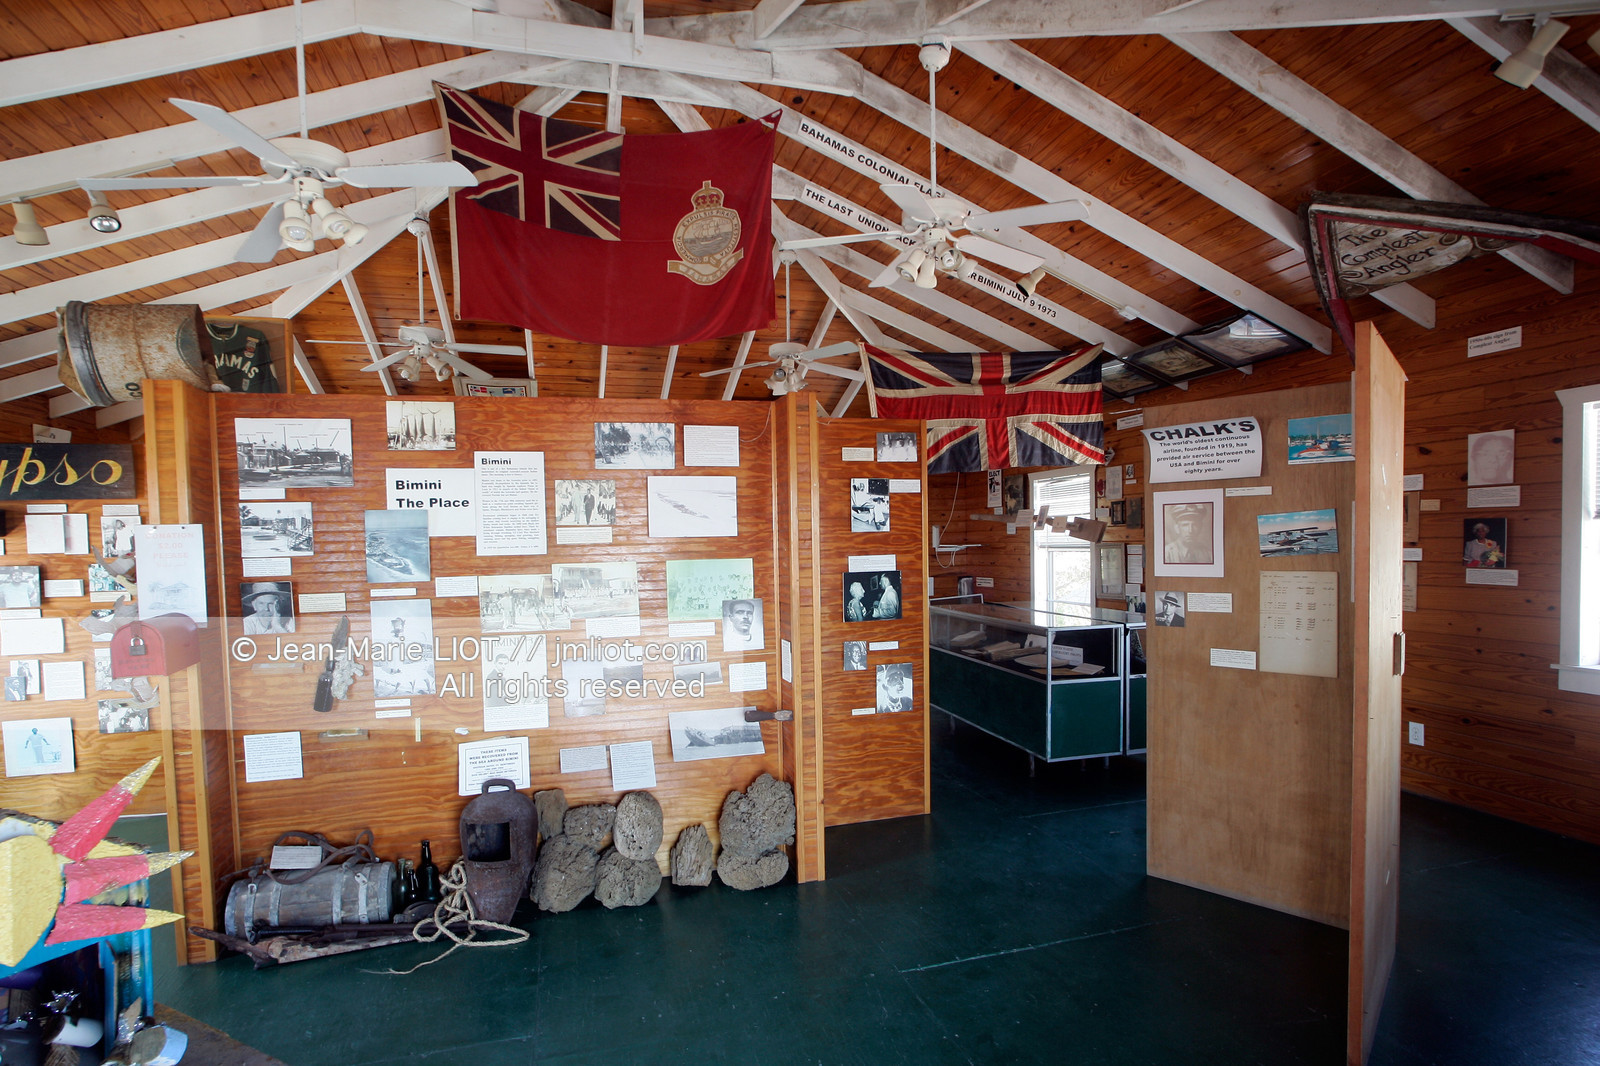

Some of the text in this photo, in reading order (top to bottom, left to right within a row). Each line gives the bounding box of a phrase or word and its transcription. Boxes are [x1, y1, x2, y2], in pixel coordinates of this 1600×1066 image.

[801, 123, 855, 158] BAHAMAS
[857, 154, 910, 185] COLONIAL
[805, 188, 825, 203] THE
[827, 199, 853, 217] LAST
[857, 214, 889, 233] UNION
[1339, 228, 1388, 247] The
[1341, 229, 1430, 266] Compleat
[1363, 246, 1435, 278] Angler
[977, 274, 1057, 318] BIMINI JULY 9 1973
[1150, 420, 1256, 441] CHALK'S
[395, 480, 442, 490] Bimini
[396, 498, 470, 508] The Place
